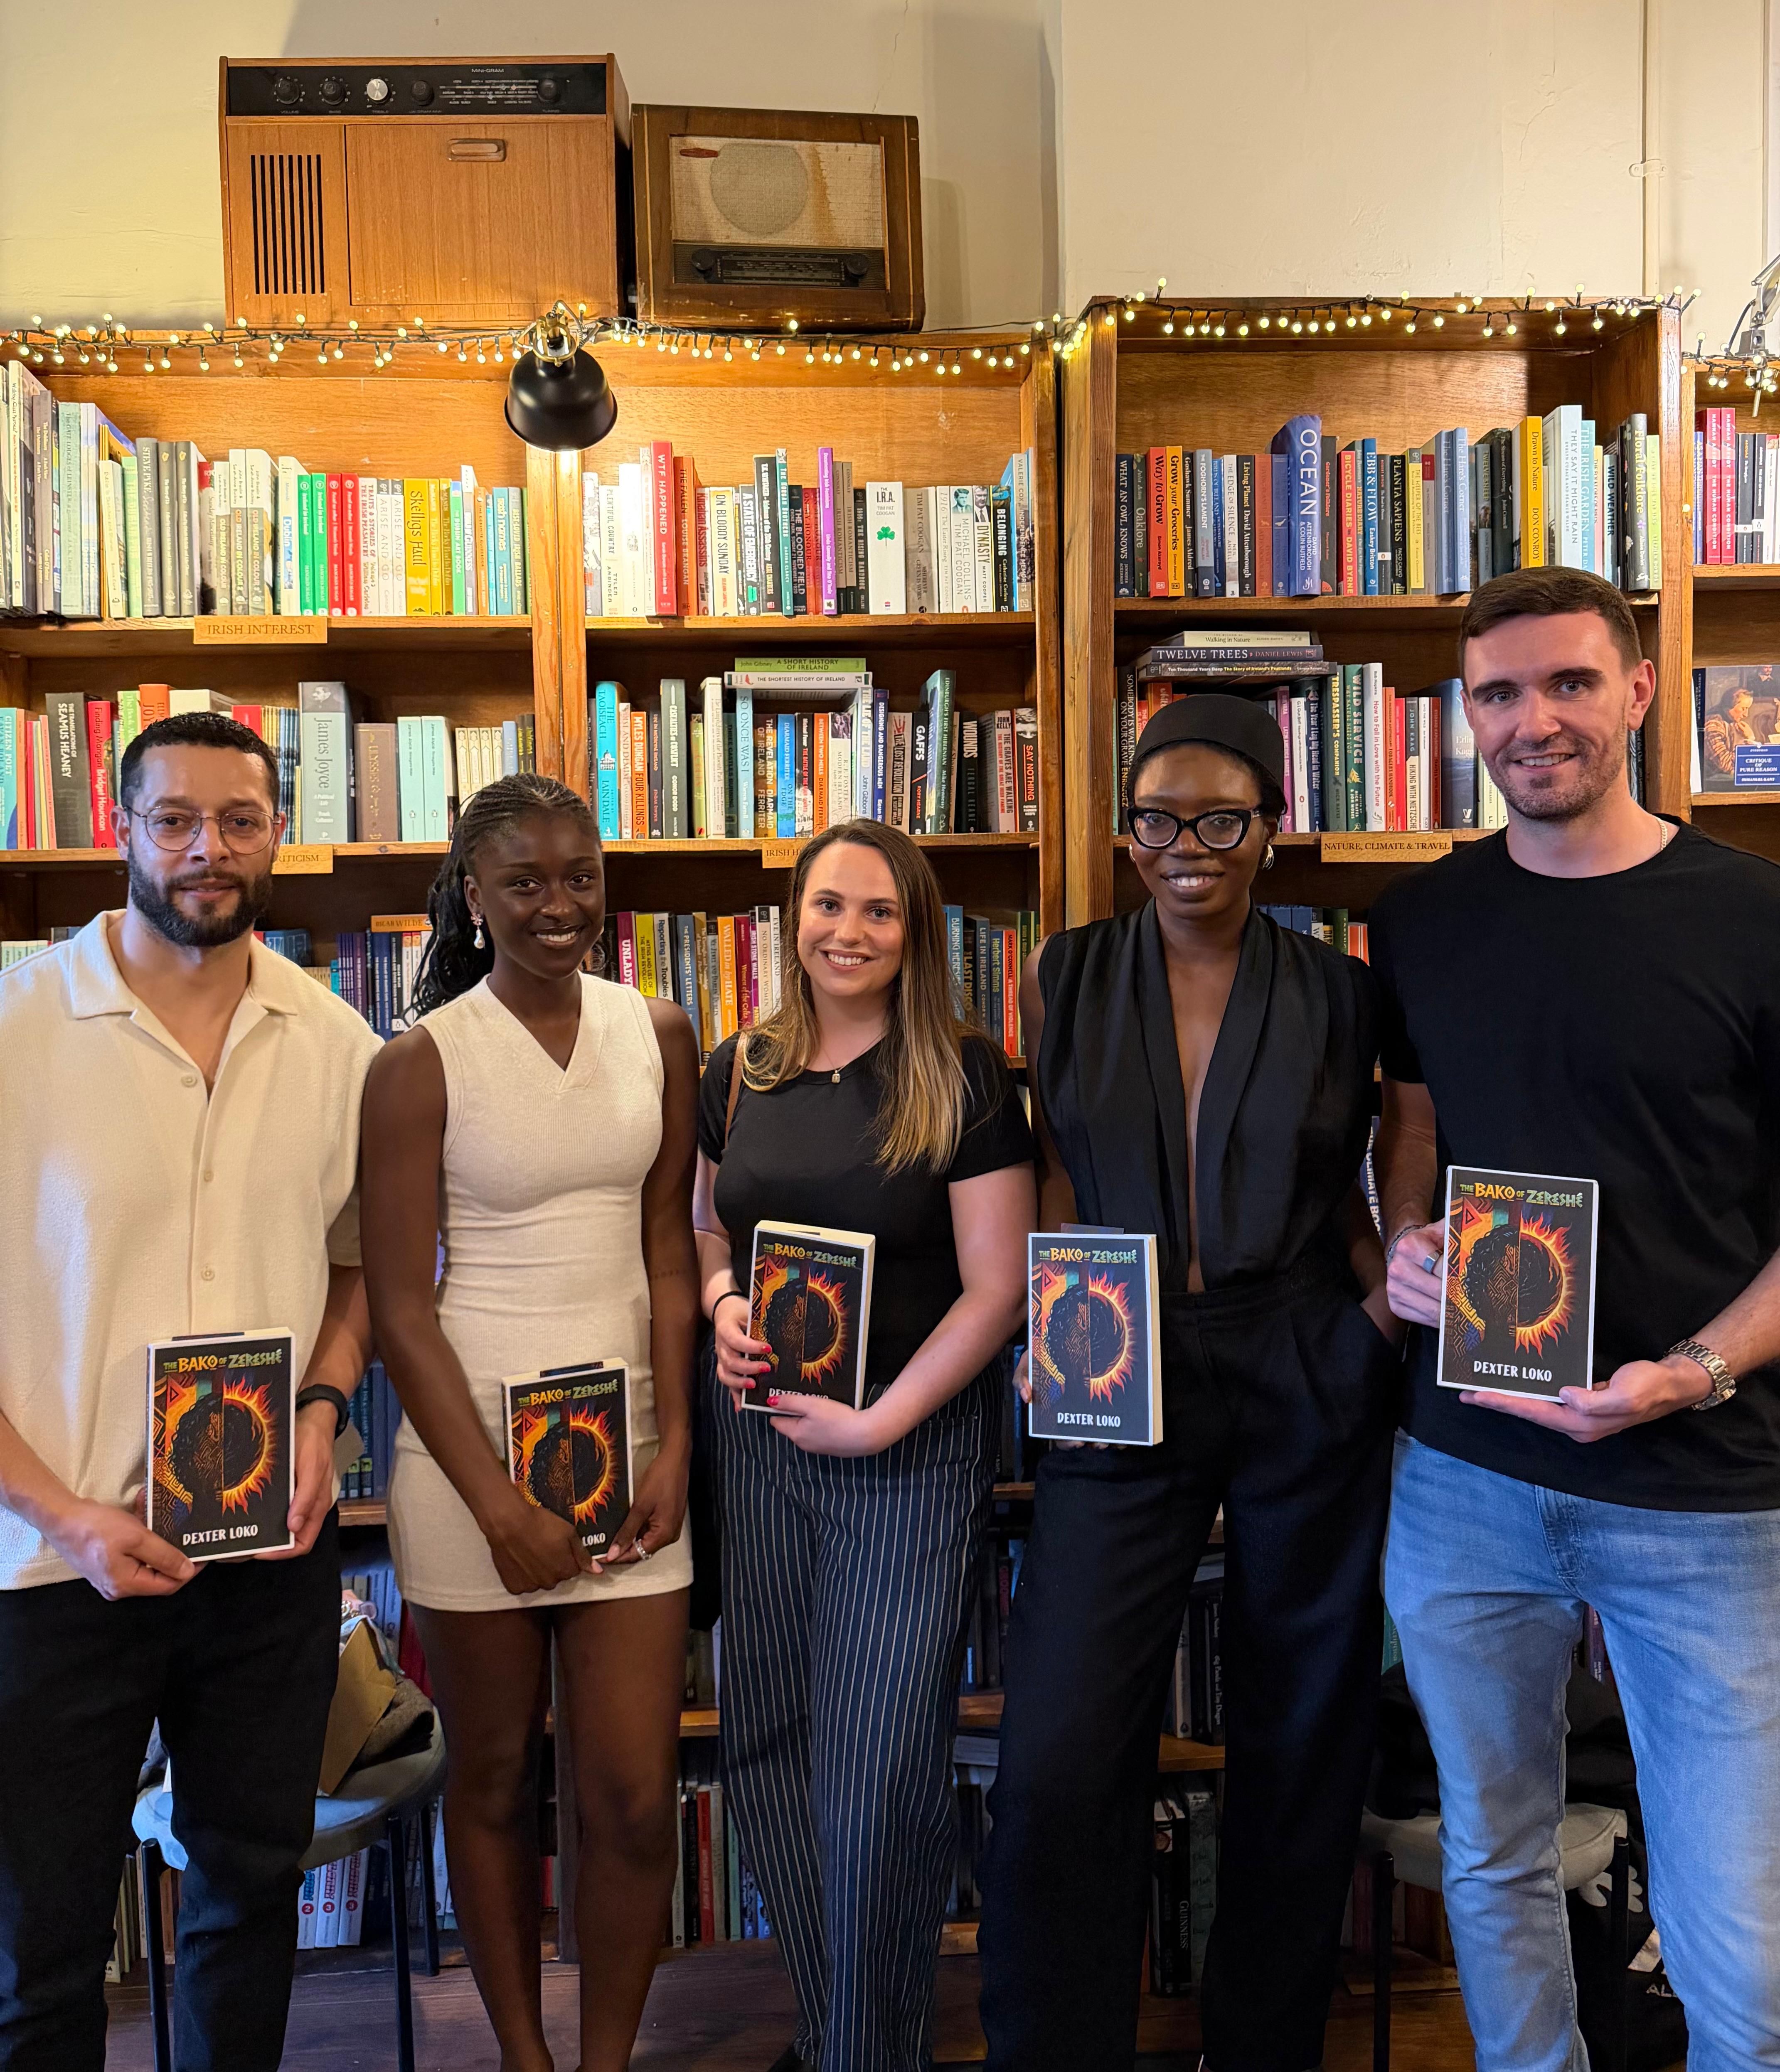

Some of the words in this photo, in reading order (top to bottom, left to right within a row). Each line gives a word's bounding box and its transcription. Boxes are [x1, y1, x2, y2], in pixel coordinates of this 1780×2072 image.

[142, 447, 150, 471] STEVE
[1634, 430, 1646, 463] Floral
[1154, 455, 1164, 480] Way
[1170, 455, 1179, 485] Grow
[1300, 429, 1317, 515] OCEAN
[1367, 452, 1375, 474] EBB
[143, 473, 151, 493] PYKE
[1156, 483, 1164, 492] to
[1367, 476, 1376, 486] &
[1635, 467, 1646, 513] Folklore
[659, 480, 667, 534] HAPPENED
[715, 494, 726, 505] ON
[876, 491, 895, 502] I.R.A.
[1120, 490, 1127, 502] AN
[1156, 494, 1164, 524] Grow
[1169, 486, 1177, 506] your
[1367, 488, 1376, 521] FLOW
[407, 491, 426, 536] Skelligs
[716, 509, 728, 540] BLOODY
[743, 500, 754, 524] STATE
[283, 519, 293, 547] Dublin
[744, 526, 755, 536] OF
[997, 508, 1007, 556] BELONGING
[1135, 507, 1146, 548] Oaklore
[1172, 508, 1180, 550] Groceries
[409, 541, 427, 566] Haul
[718, 542, 729, 573] SUNDAY
[977, 525, 990, 563] DYNASTY
[745, 537, 757, 582] EMERGENCY
[207, 625, 243, 634] IRISH
[248, 624, 315, 634] INTEREST
[1157, 650, 1207, 660] TWELVE
[1210, 649, 1248, 659] TREES
[741, 696, 749, 710] SO
[1352, 674, 1361, 706] WILD
[58, 703, 69, 740] SEAMUS
[94, 707, 103, 734] Finding
[741, 713, 749, 742] ONCE
[315, 718, 332, 755] James
[915, 725, 925, 760] GAFFS
[963, 721, 978, 758] WOUNDS
[1353, 711, 1363, 764] SERVICE
[60, 741, 71, 777] HEANEY
[94, 736, 102, 767] Mangan
[314, 757, 332, 788] Joyce
[635, 773, 643, 791] FOUR
[635, 793, 645, 825] KILLINGS
[278, 854, 319, 863] ITICISM
[1324, 842, 1363, 851] NATURE,
[992, 938, 1000, 966] Herbert
[1459, 1184, 1474, 1192] THE
[1474, 1182, 1515, 1200] BAKO
[1525, 1190, 1583, 1208] ZERESHÉ
[774, 1243, 805, 1258] BAKO
[813, 1251, 857, 1268] ZERESHÉ
[1039, 1250, 1050, 1258] THE
[1050, 1248, 1083, 1261] BAKO
[1092, 1249, 1137, 1263] ZERESHÉ
[163, 1362, 177, 1371] THE
[177, 1355, 219, 1373] BAKO
[219, 1357, 227, 1365] OF
[228, 1349, 283, 1369] ZERESHÉ
[1473, 1360, 1517, 1378] DEXTER
[1521, 1367, 1552, 1381] LOKO
[517, 1396, 529, 1405] THE
[529, 1388, 564, 1406] BAKO
[571, 1379, 618, 1399] ZERESHÉ
[1057, 1412, 1093, 1426] DEXTER
[1096, 1415, 1121, 1428] LOKO
[182, 1529, 227, 1546] DEXTER
[229, 1524, 259, 1541] LOKO
[581, 1532, 606, 1546] LOKO
[1179, 1900, 1189, 1949] GUINNESS
